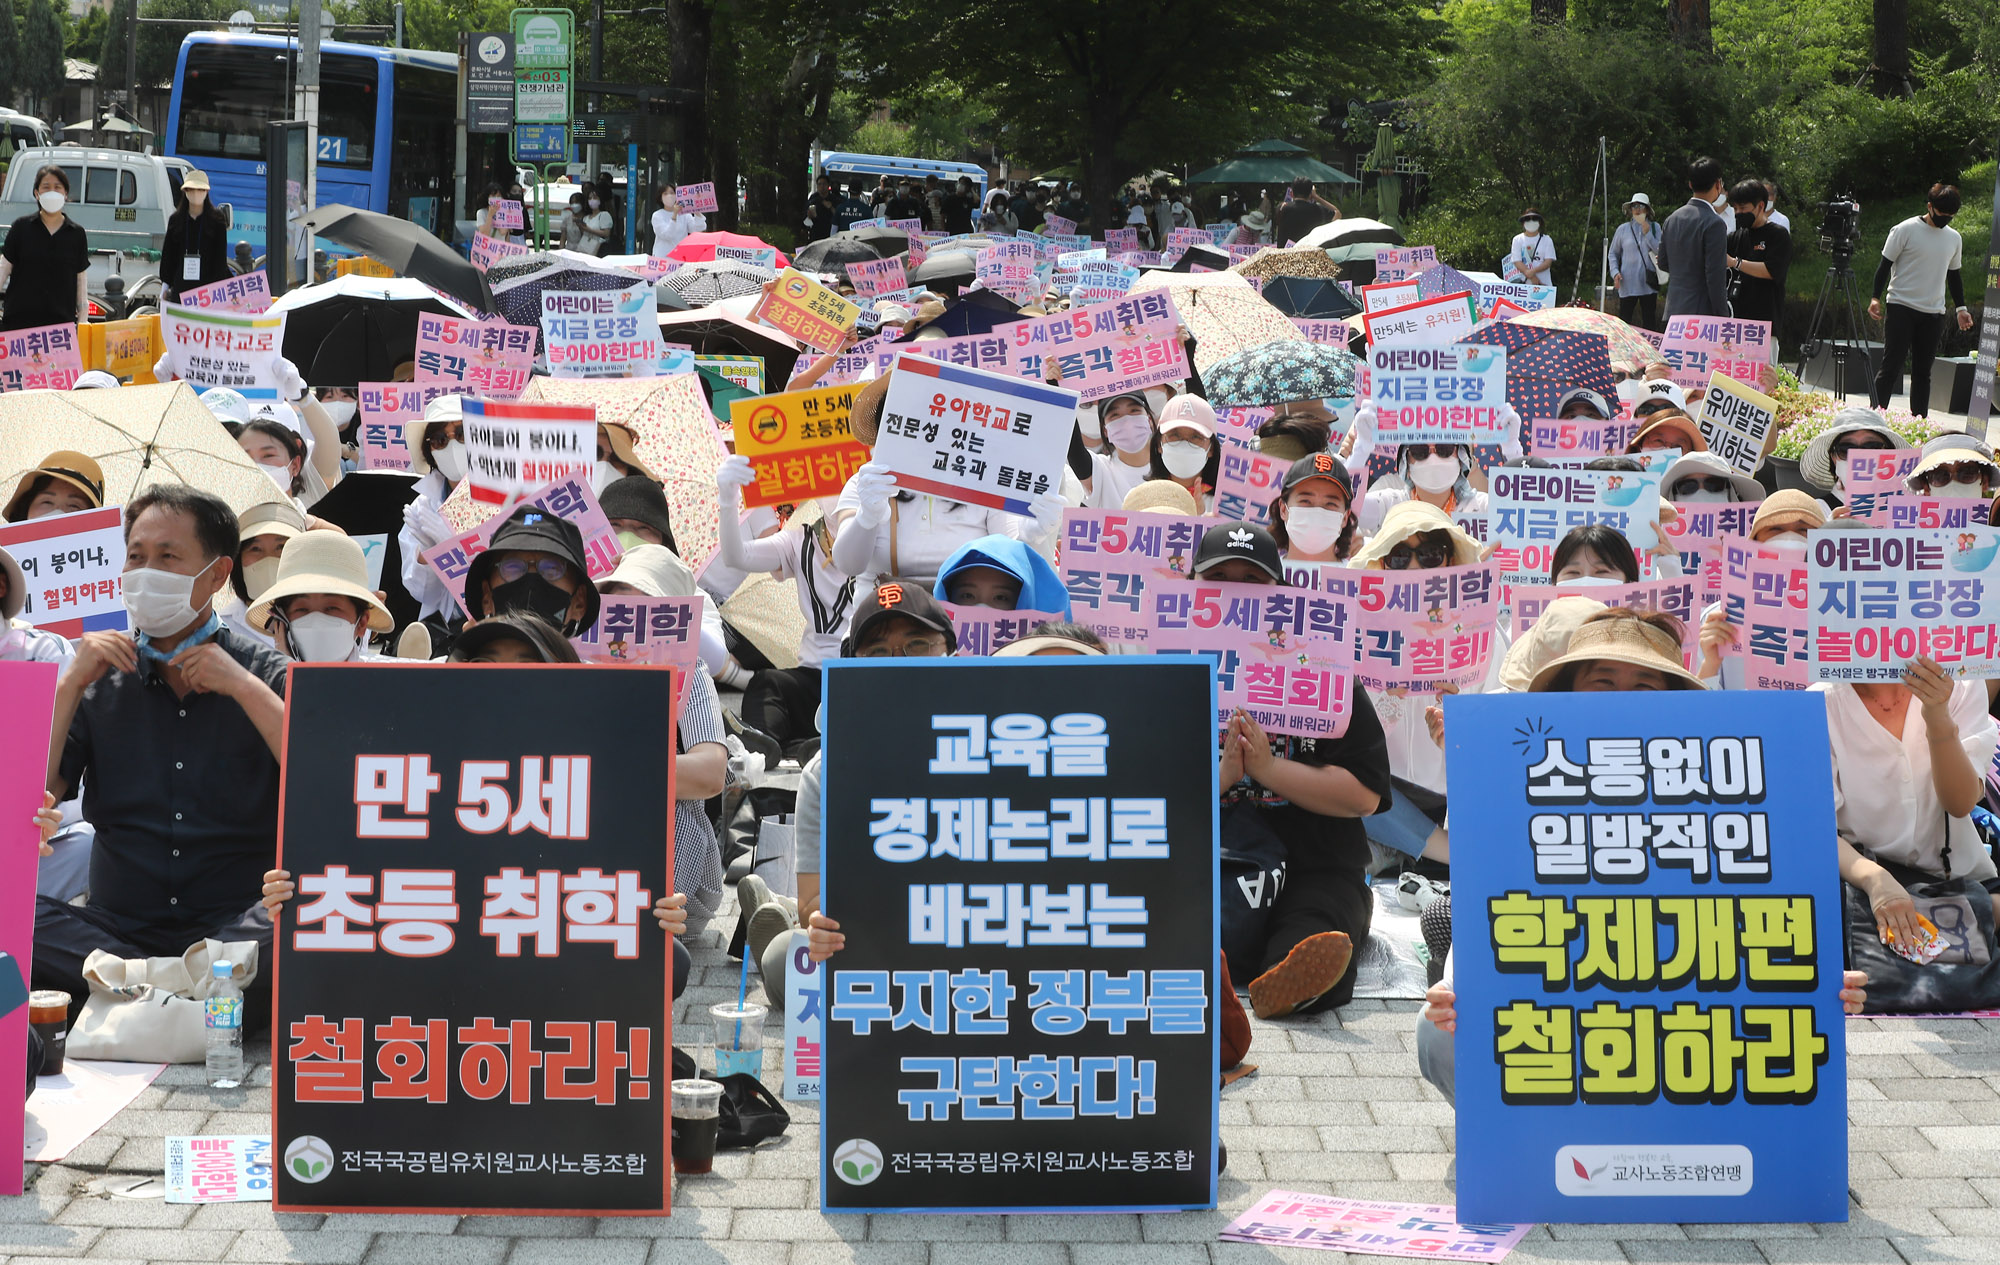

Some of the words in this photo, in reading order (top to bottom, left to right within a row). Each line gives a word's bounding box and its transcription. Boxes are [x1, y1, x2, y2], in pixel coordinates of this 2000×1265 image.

[519, 83, 564, 92] 전쟁기념관
[318, 138, 341, 160] 21
[676, 184, 712, 198] 만5세취학
[1106, 228, 1136, 238] 만5세취학
[472, 253, 489, 268] 즉각
[717, 249, 753, 260] 어린이는
[978, 243, 1032, 261] 만5세취학
[1377, 249, 1434, 265] 만5세취학
[848, 259, 899, 277] 만5세취학
[977, 263, 1002, 277] 즉각
[1081, 275, 1103, 287] 지금
[1107, 276, 1131, 289] 당장
[1082, 262, 1119, 274] 어린이는
[546, 294, 614, 314] 어린이는
[818, 290, 830, 302] 만
[830, 296, 845, 311] 5세
[1483, 285, 1528, 298] 어린이는
[767, 301, 839, 350] 철회하라
[808, 301, 846, 326] 초등취학
[1050, 294, 1169, 345] 만5세취학
[1374, 320, 1418, 340] 만5세는
[1425, 307, 1467, 329] 유치원!
[173, 324, 274, 352] 유아학교로
[421, 320, 531, 353] 만5세취학
[548, 318, 589, 341] 지금
[594, 316, 638, 341] 당장
[1669, 318, 1766, 346] 만5세취학
[548, 341, 655, 365] 놀아야한다!
[1059, 345, 1114, 379] 즉각
[1116, 337, 1183, 376] 철회!
[1375, 351, 1458, 371] 어린이는
[1664, 349, 1709, 373] 즉각
[184, 369, 218, 384] 교육과
[418, 350, 467, 381] 즉각
[469, 365, 525, 392] 철회!
[1107, 376, 1151, 393] 방구뽕에게
[1153, 367, 1182, 383] 배워라!
[1377, 377, 1428, 401] 지금
[1433, 377, 1485, 401] 당장
[803, 398, 820, 417] 만
[825, 394, 852, 414] 5세
[928, 393, 1032, 436] 유아학교로
[1179, 400, 1196, 417] A
[1704, 386, 1770, 441] 유아발달
[885, 412, 938, 443] 전문성
[951, 428, 985, 454] 있는
[932, 451, 987, 480] 교육과
[998, 465, 1050, 495] 돌봄을
[1495, 474, 1596, 503] 어린이는
[1495, 507, 1559, 539] 지금
[1226, 540, 1254, 550] adidas
[1815, 537, 1944, 571] 어린이는
[51, 546, 109, 574] 봉이냐,
[1066, 569, 1144, 613] 즉각
[1818, 580, 1899, 619] 지금
[1908, 578, 1984, 619] 당장
[1157, 588, 1349, 642] 만5세취학
[1124, 626, 1149, 641] 방구
[1410, 632, 1488, 675] 철회!
[1819, 668, 1863, 678] 윤석열은
[1245, 662, 1345, 715] 철회!
[1290, 714, 1336, 734] 배워라!
[929, 713, 1109, 776] 교육을
[1527, 737, 1765, 800] 소통없이
[354, 754, 441, 839] 만
[455, 755, 591, 839] 5세
[869, 797, 1170, 862] 경제논리로
[1530, 813, 1770, 880] 일방적인
[293, 865, 459, 957] 초등
[480, 868, 650, 959] 취학
[909, 883, 1148, 948] 바라보는
[1489, 892, 1818, 988] 학제개편
[831, 968, 1016, 1035] 무지한
[1028, 969, 1208, 1035] 정부를
[288, 1015, 650, 1105] 철회하라!
[1496, 1002, 1827, 1100] 철회하라
[898, 1054, 1157, 1121] 규탄한다!
[341, 1149, 647, 1176] 전국국공립유치원교사노동조합
[890, 1149, 1195, 1175] 전국국공립유치원교사노동조합
[1612, 1164, 1742, 1182] 교사노동조합연맹
[1237, 1222, 1497, 1254] 만5세취학
